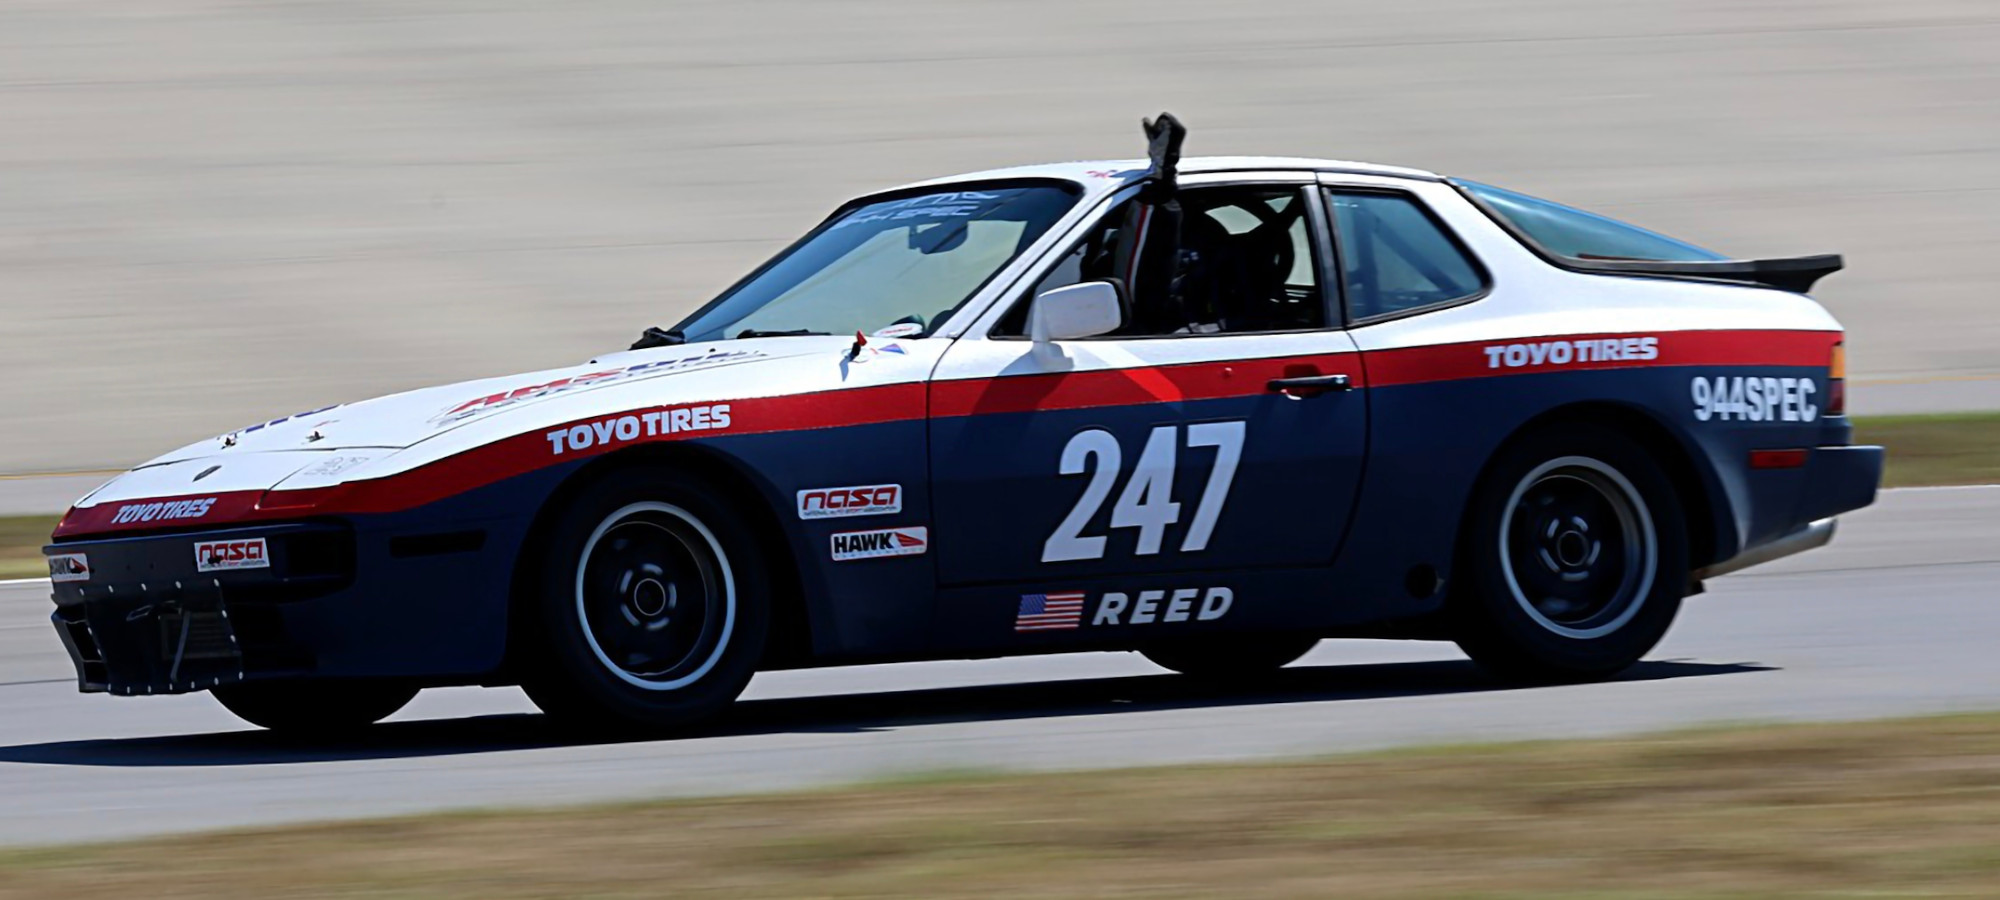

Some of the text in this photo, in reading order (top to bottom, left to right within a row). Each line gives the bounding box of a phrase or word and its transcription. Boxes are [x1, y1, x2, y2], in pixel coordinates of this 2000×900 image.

[1041, 420, 1246, 563] 247
[833, 531, 895, 554] HAWK
[1092, 586, 1234, 626] REED
